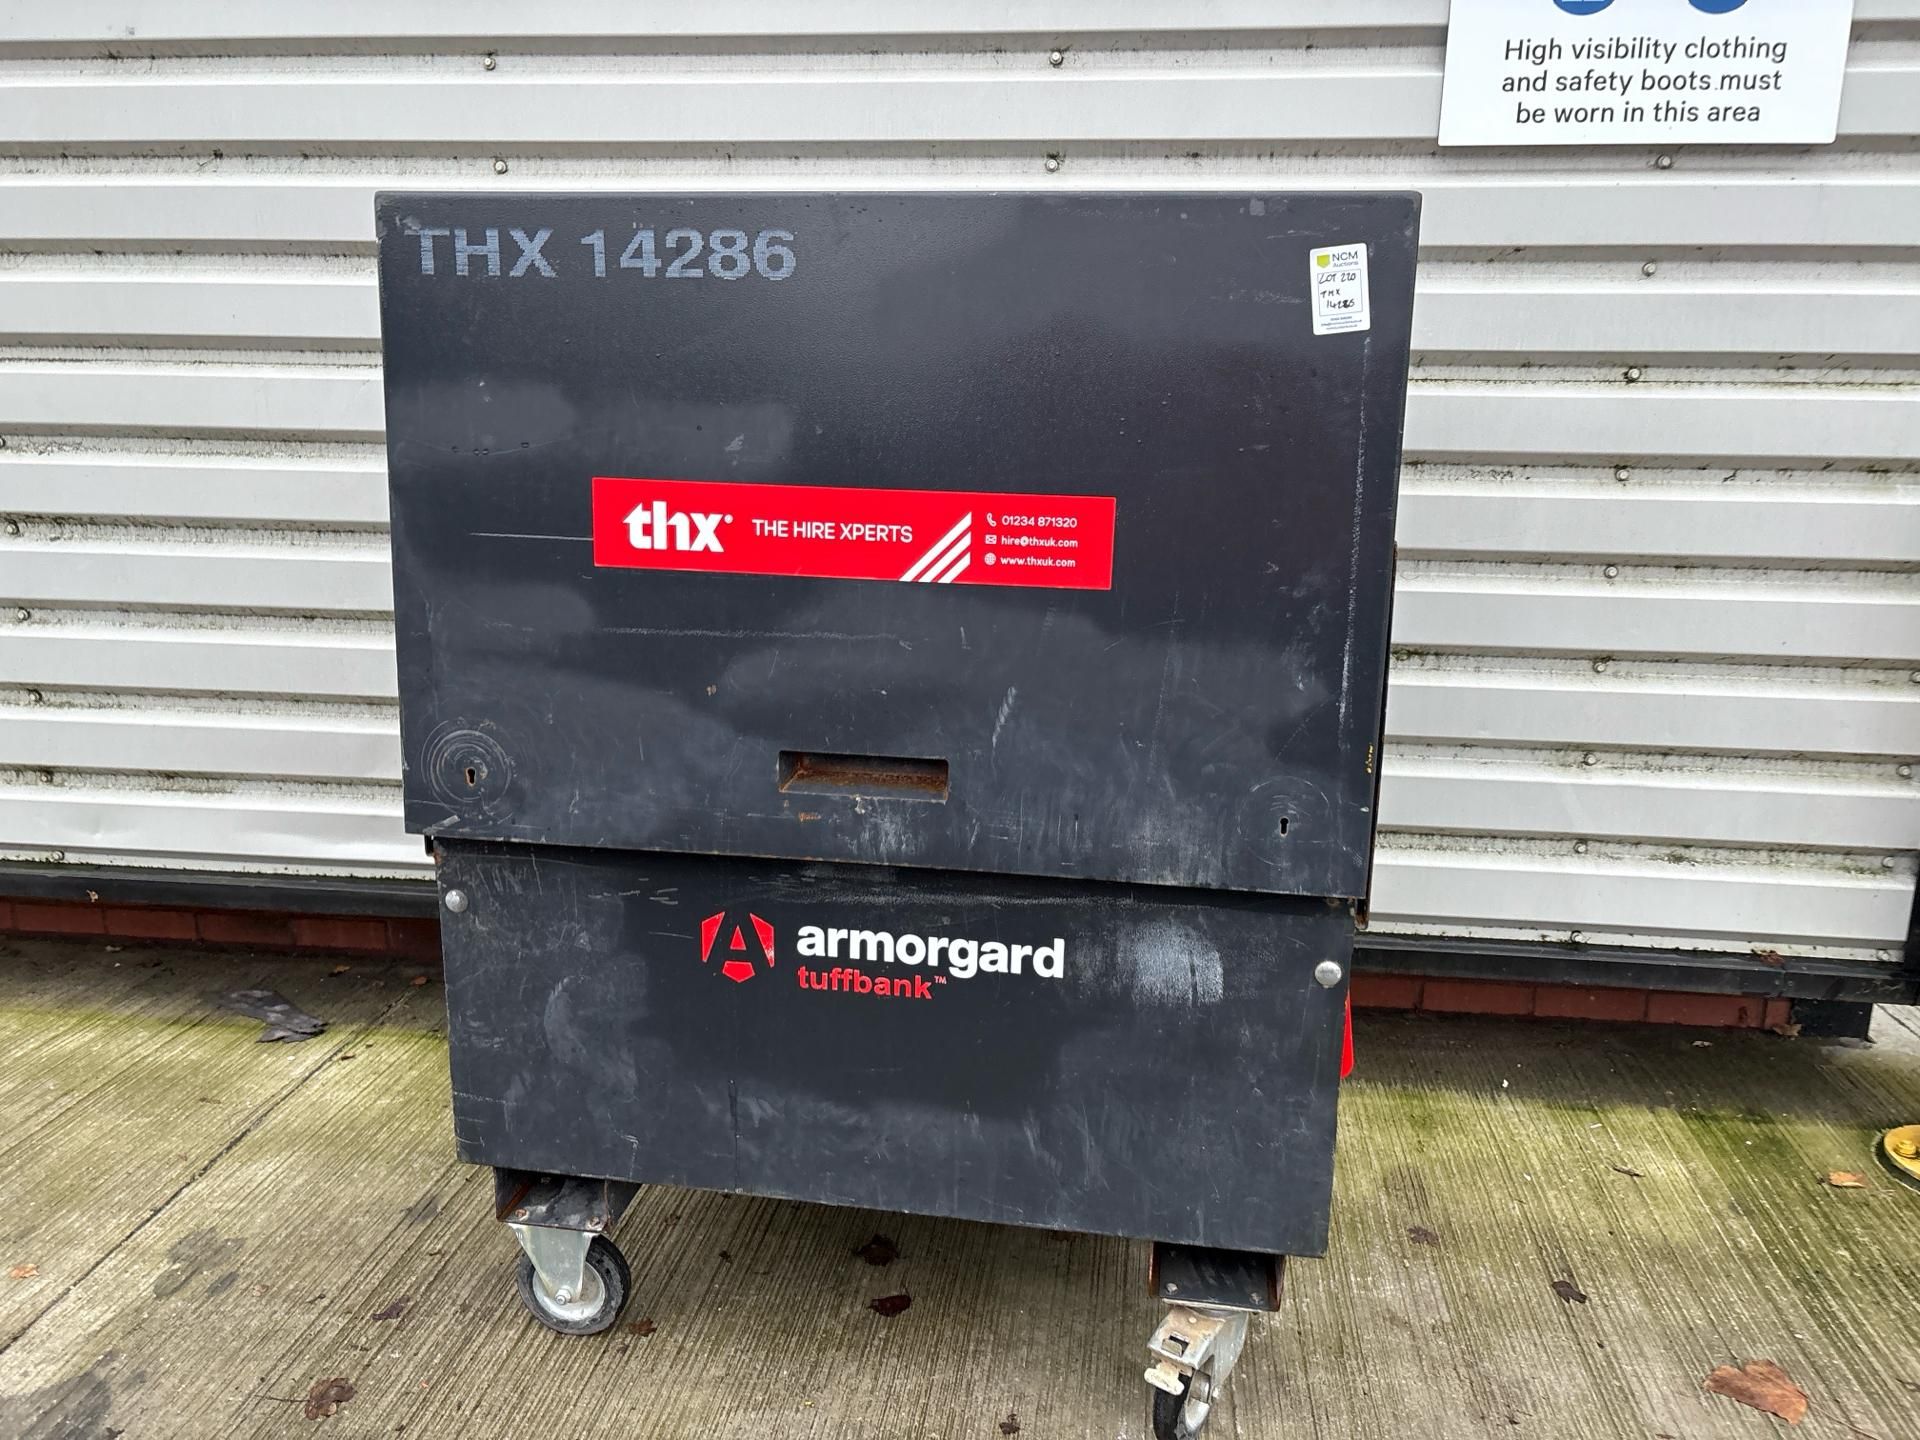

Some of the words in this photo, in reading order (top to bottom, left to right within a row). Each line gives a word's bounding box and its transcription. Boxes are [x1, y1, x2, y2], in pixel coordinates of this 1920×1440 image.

[1505, 38, 1562, 64] High
[1572, 37, 1677, 64] visibility
[1685, 36, 1788, 63] clothing
[1502, 70, 1547, 91] and
[1556, 69, 1632, 95] safety
[1641, 69, 1711, 91] boots
[1721, 70, 1782, 90] must
[1516, 102, 1545, 123] be
[1554, 106, 1614, 122] worn
[1623, 102, 1644, 122] in
[1654, 101, 1699, 122] this
[1708, 105, 1761, 121] area
[404, 227, 558, 278] THX
[580, 229, 797, 281] 14286
[1332, 251, 1358, 261] NCM
[1319, 272, 1336, 284] LOT
[1340, 272, 1356, 282] 220
[1320, 289, 1340, 298] THX
[1001, 515, 1035, 526] 01234
[1037, 516, 1078, 528] 871320
[752, 518, 788, 538] THE
[793, 521, 835, 540] HIRE
[840, 523, 913, 543] XPERTS
[1001, 535, 1078, 548] hire@thxuk.com
[1000, 556, 1076, 568] www.thxuk.com
[797, 925, 1065, 979] armorgard
